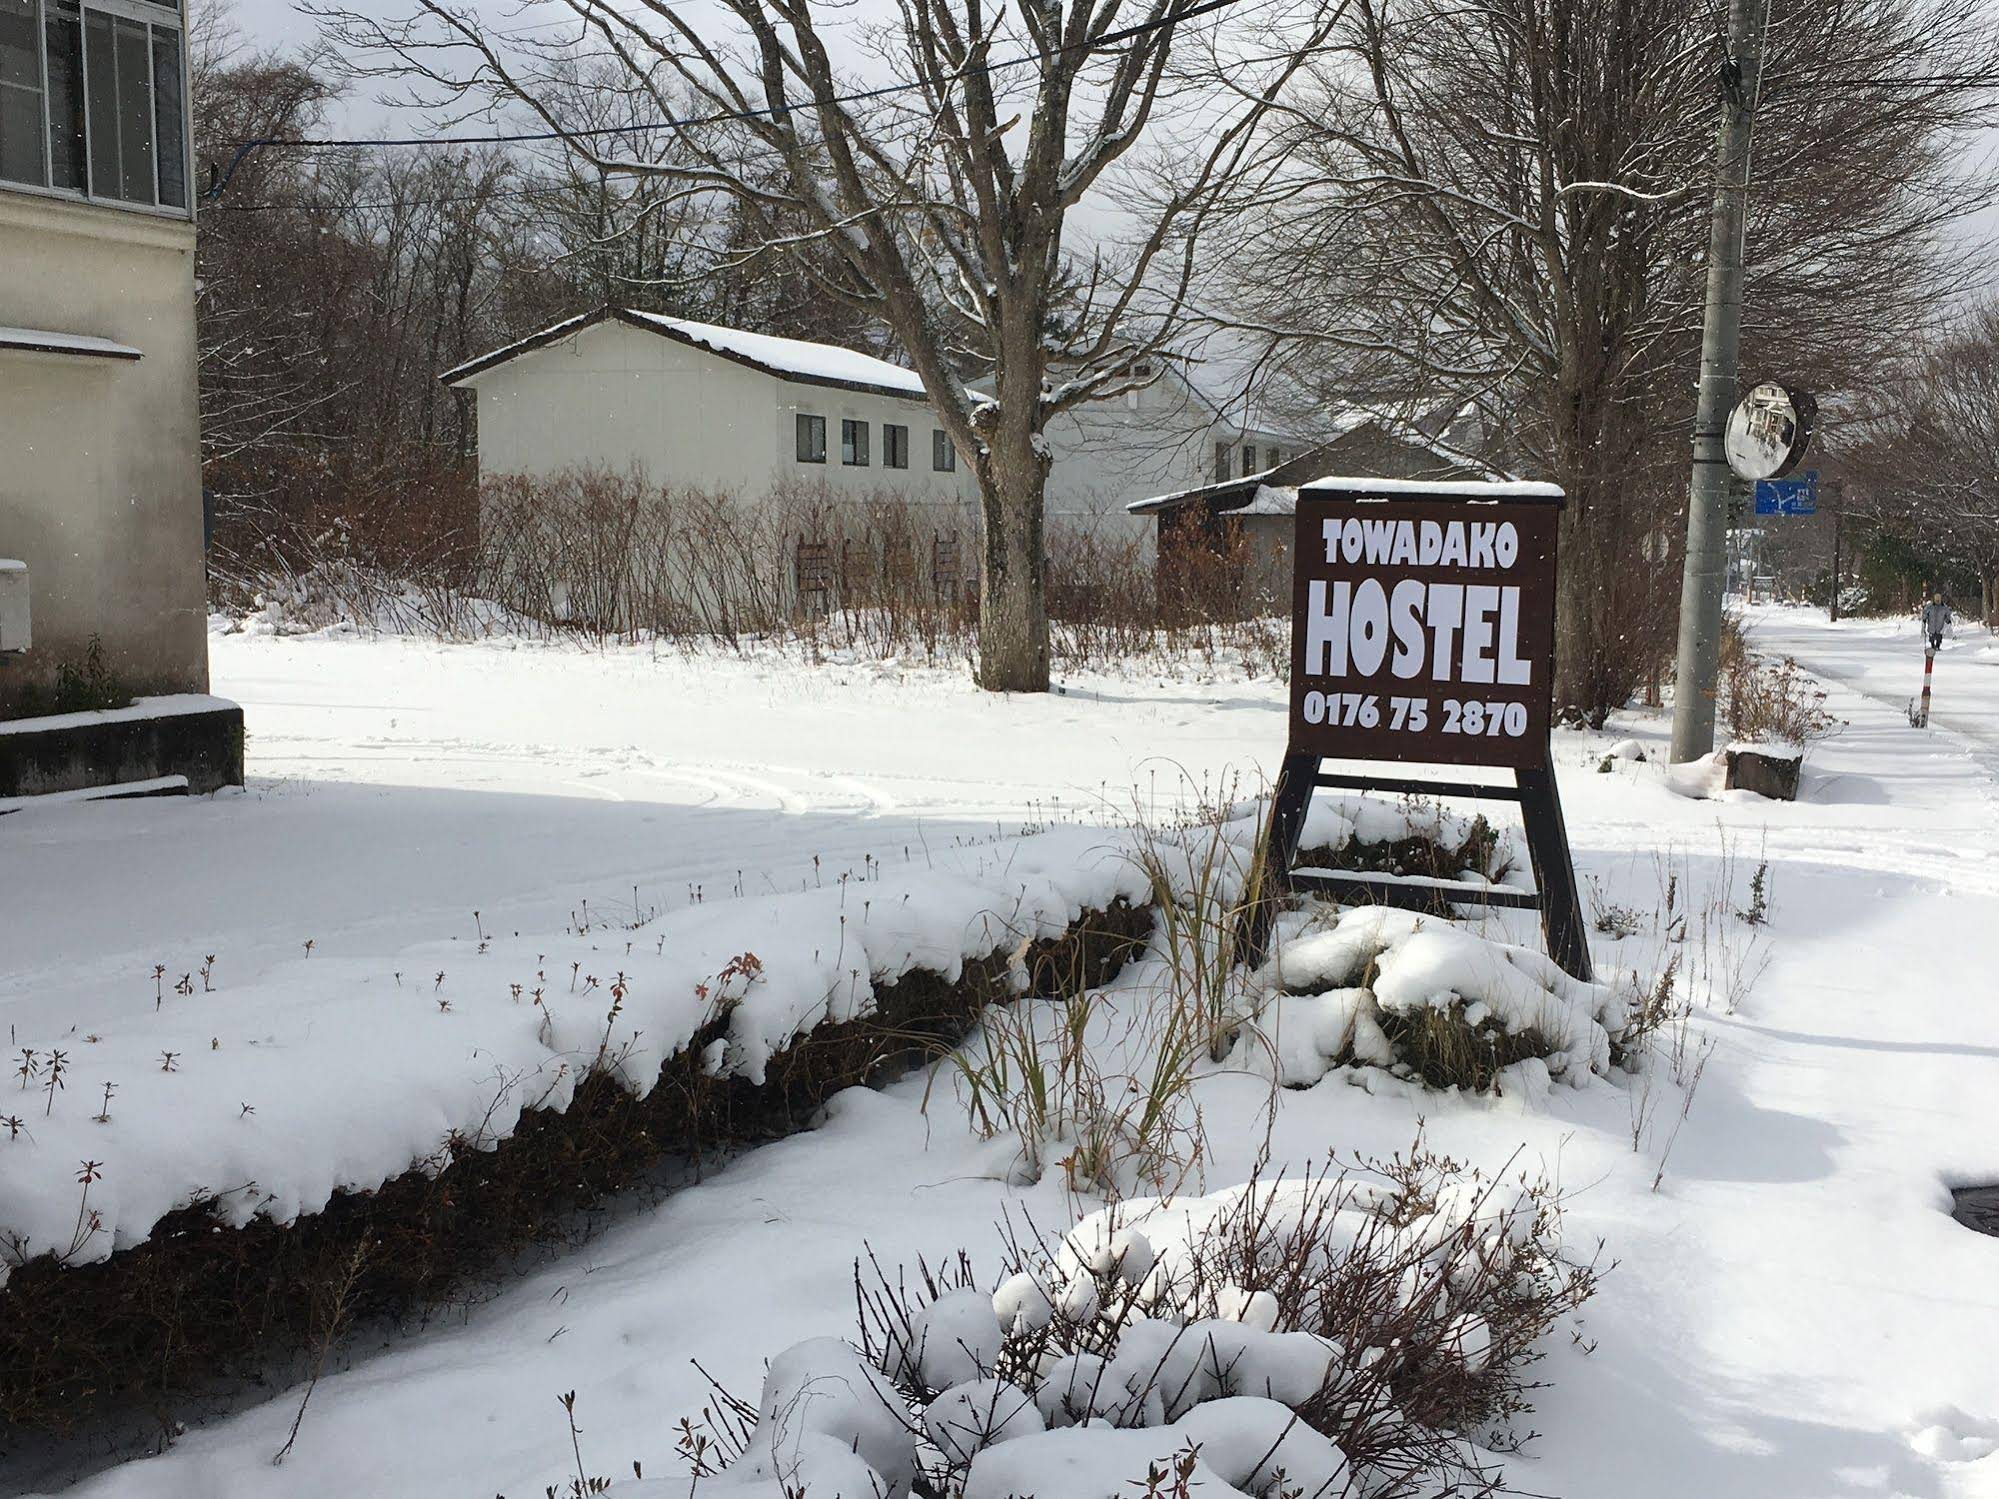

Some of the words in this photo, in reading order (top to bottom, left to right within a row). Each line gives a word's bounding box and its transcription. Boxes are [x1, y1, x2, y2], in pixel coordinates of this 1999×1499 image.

[1322, 518, 1519, 569] TOWADAKO
[1305, 578, 1532, 685] HOSTEL
[1303, 691, 1380, 729] 0176
[1389, 697, 1428, 732] 75
[1441, 699, 1528, 737] 2870
